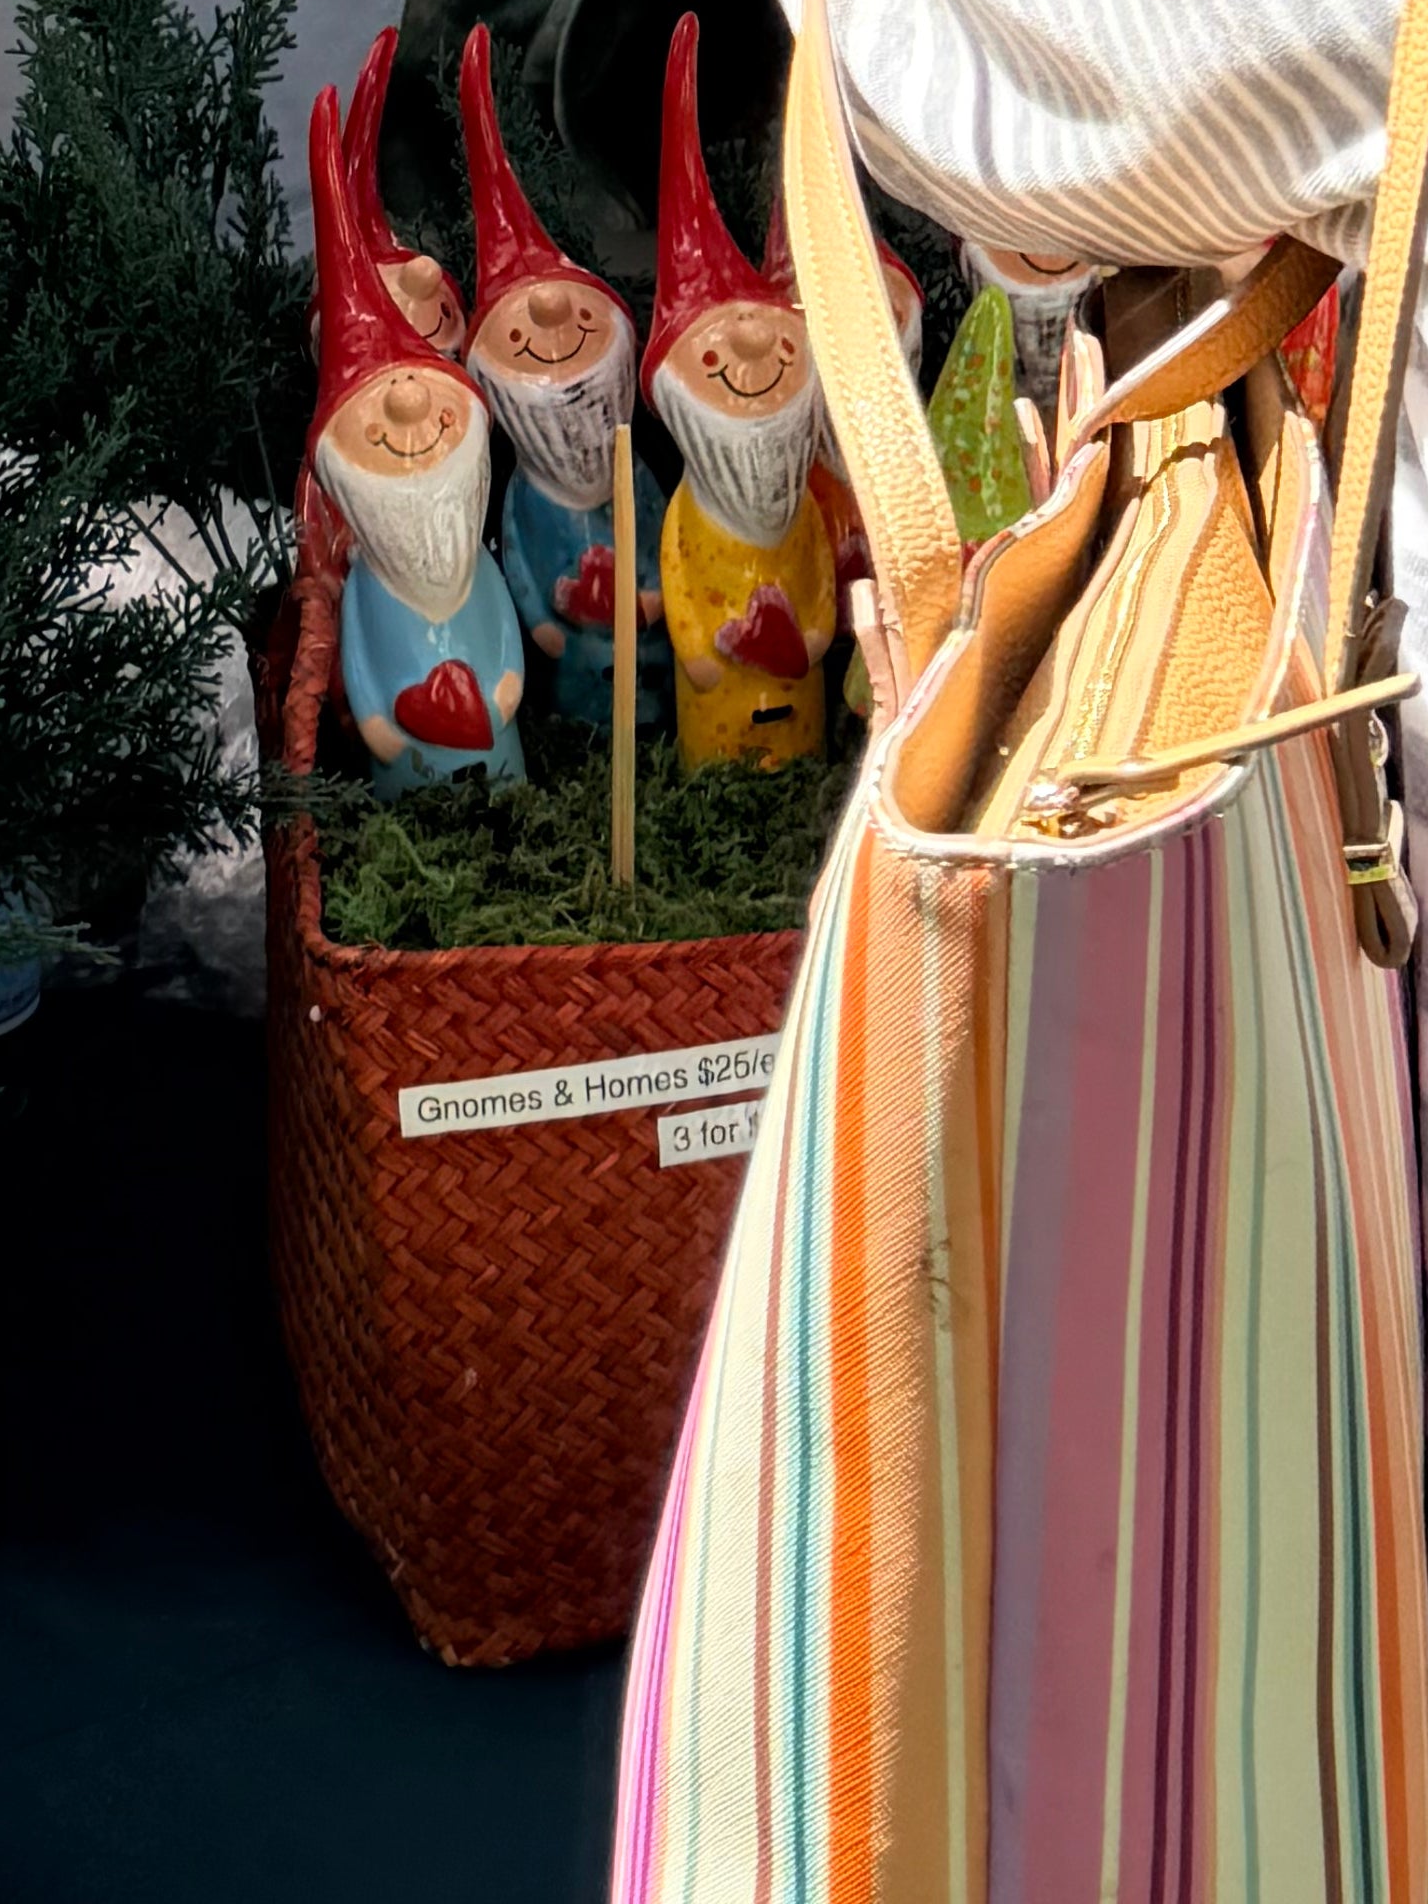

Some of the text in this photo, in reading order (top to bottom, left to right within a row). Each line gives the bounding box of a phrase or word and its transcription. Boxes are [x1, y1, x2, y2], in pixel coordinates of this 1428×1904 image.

[417, 1087, 543, 1124] Gnomes
[554, 1079, 574, 1107] &
[584, 1064, 689, 1103] Homes
[673, 1125, 691, 1152] 3
[701, 1118, 740, 1148] for
